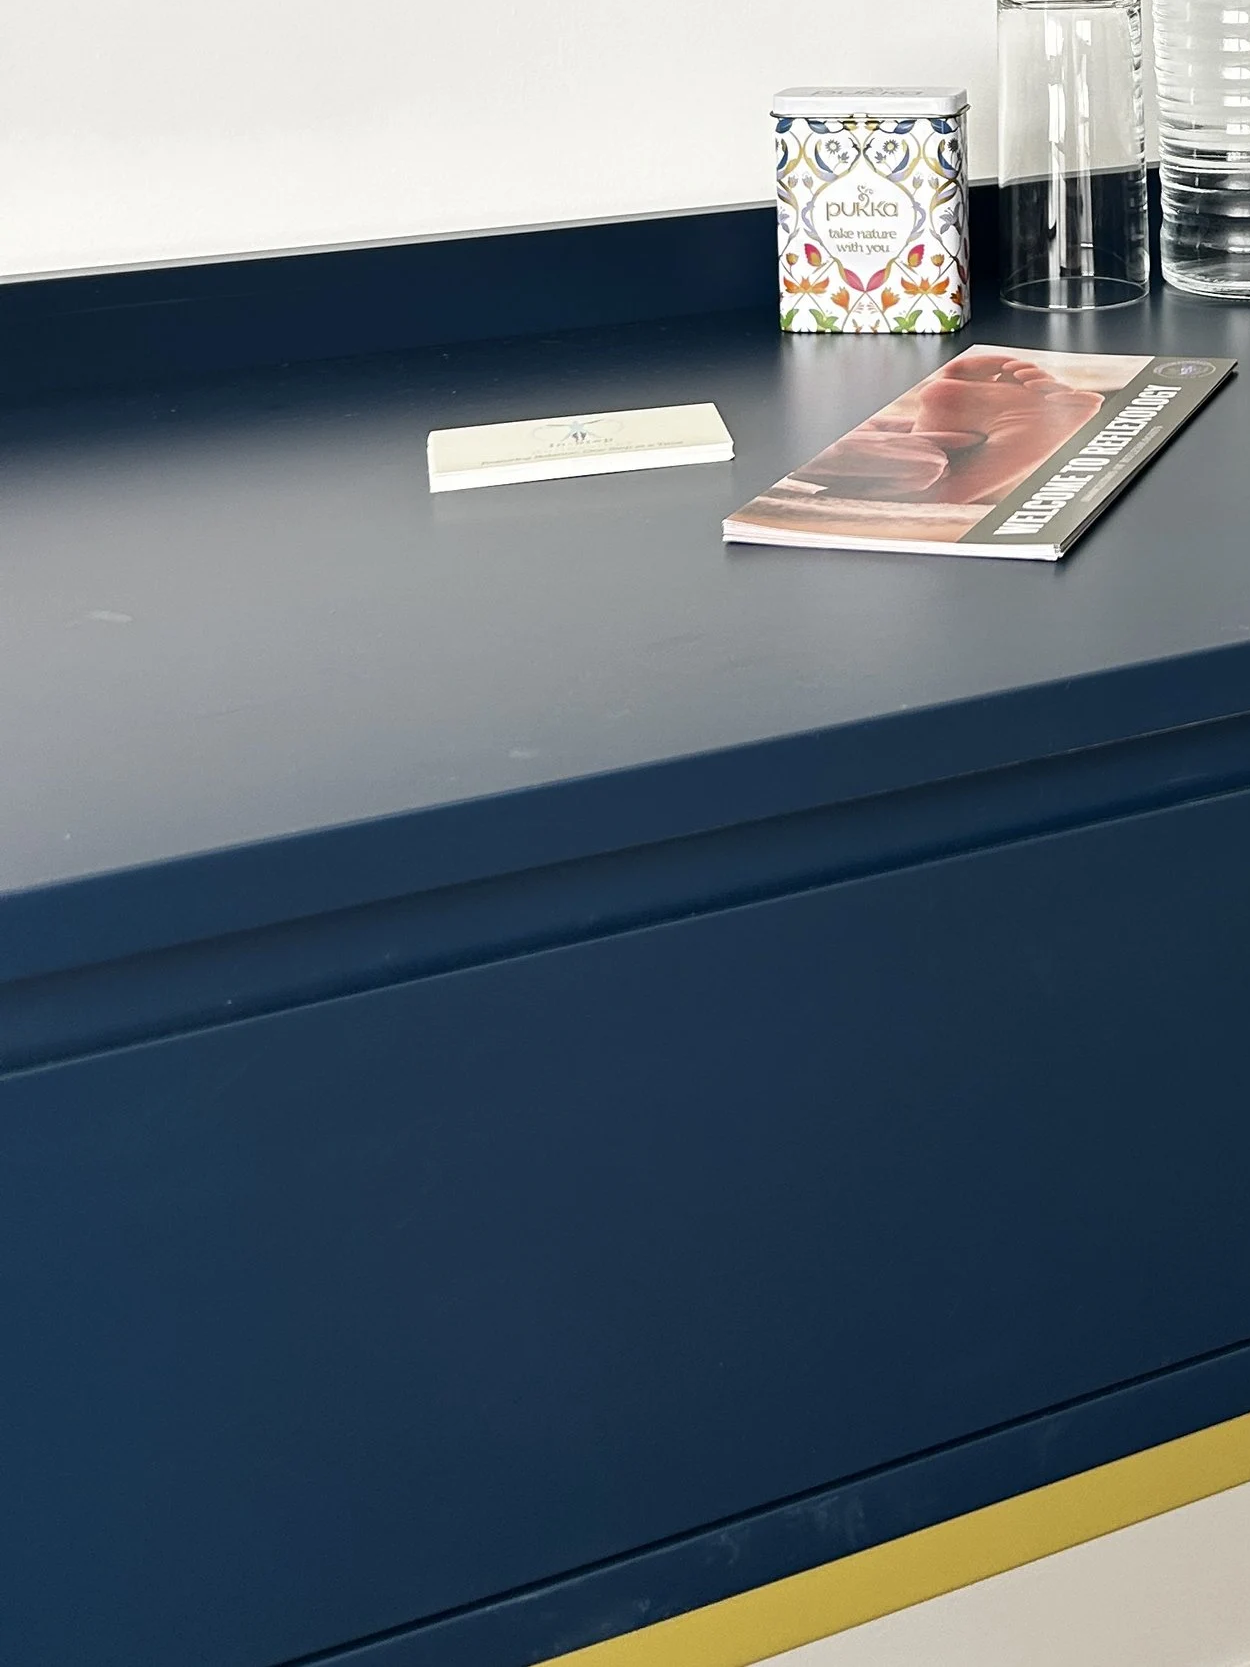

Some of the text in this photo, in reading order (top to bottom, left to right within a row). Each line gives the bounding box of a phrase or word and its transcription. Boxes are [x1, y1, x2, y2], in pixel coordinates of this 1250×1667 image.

[829, 228, 897, 239] take nature
[836, 242, 890, 255] with you
[1078, 384, 1182, 456] REFLEXOLOGY
[1059, 457, 1111, 472] TO
[993, 474, 1094, 535] WELCOME
